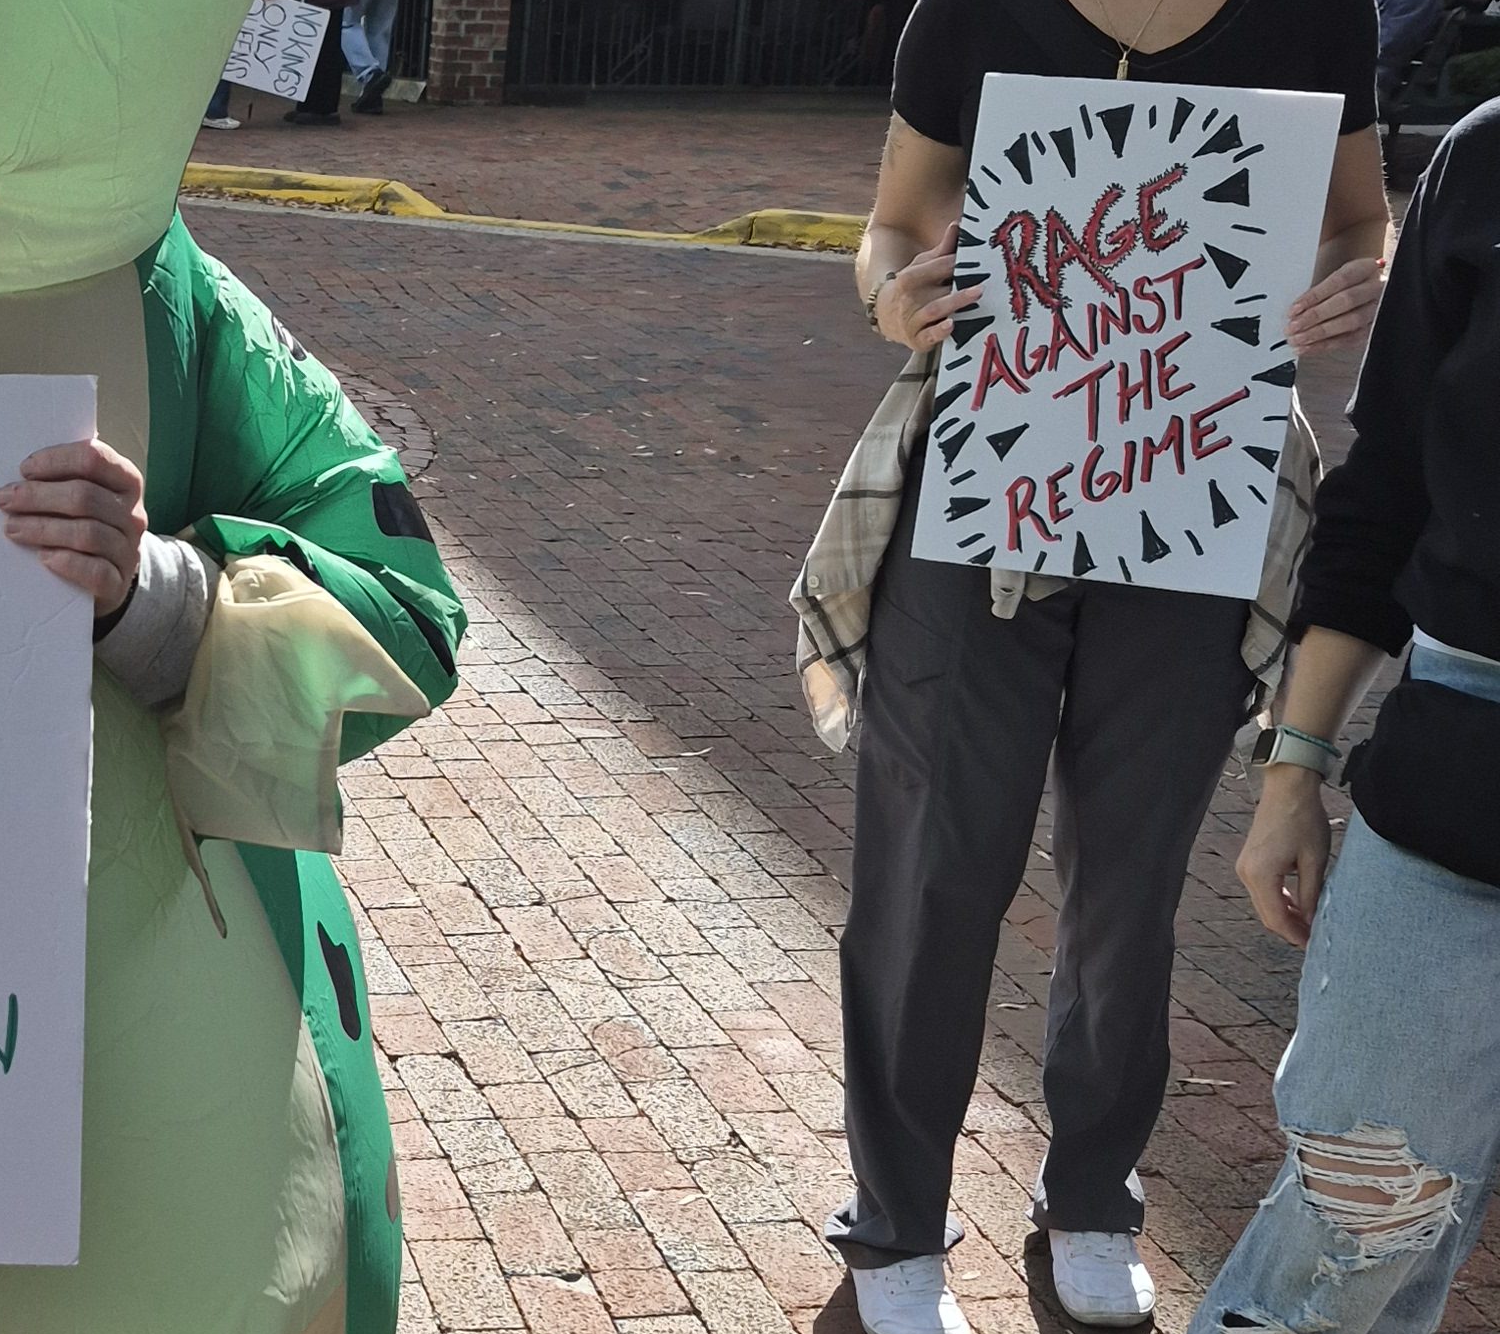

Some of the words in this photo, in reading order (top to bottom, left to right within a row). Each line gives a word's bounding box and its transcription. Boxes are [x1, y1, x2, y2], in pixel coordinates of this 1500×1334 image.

[253, 3, 287, 75] ONLY
[273, 37, 314, 97] KINGS
[292, 6, 323, 38] NO
[988, 162, 1190, 322] RAGE
[970, 254, 1207, 411] AGAINST
[1052, 331, 1197, 443] THE
[1004, 386, 1251, 552] REGIME
